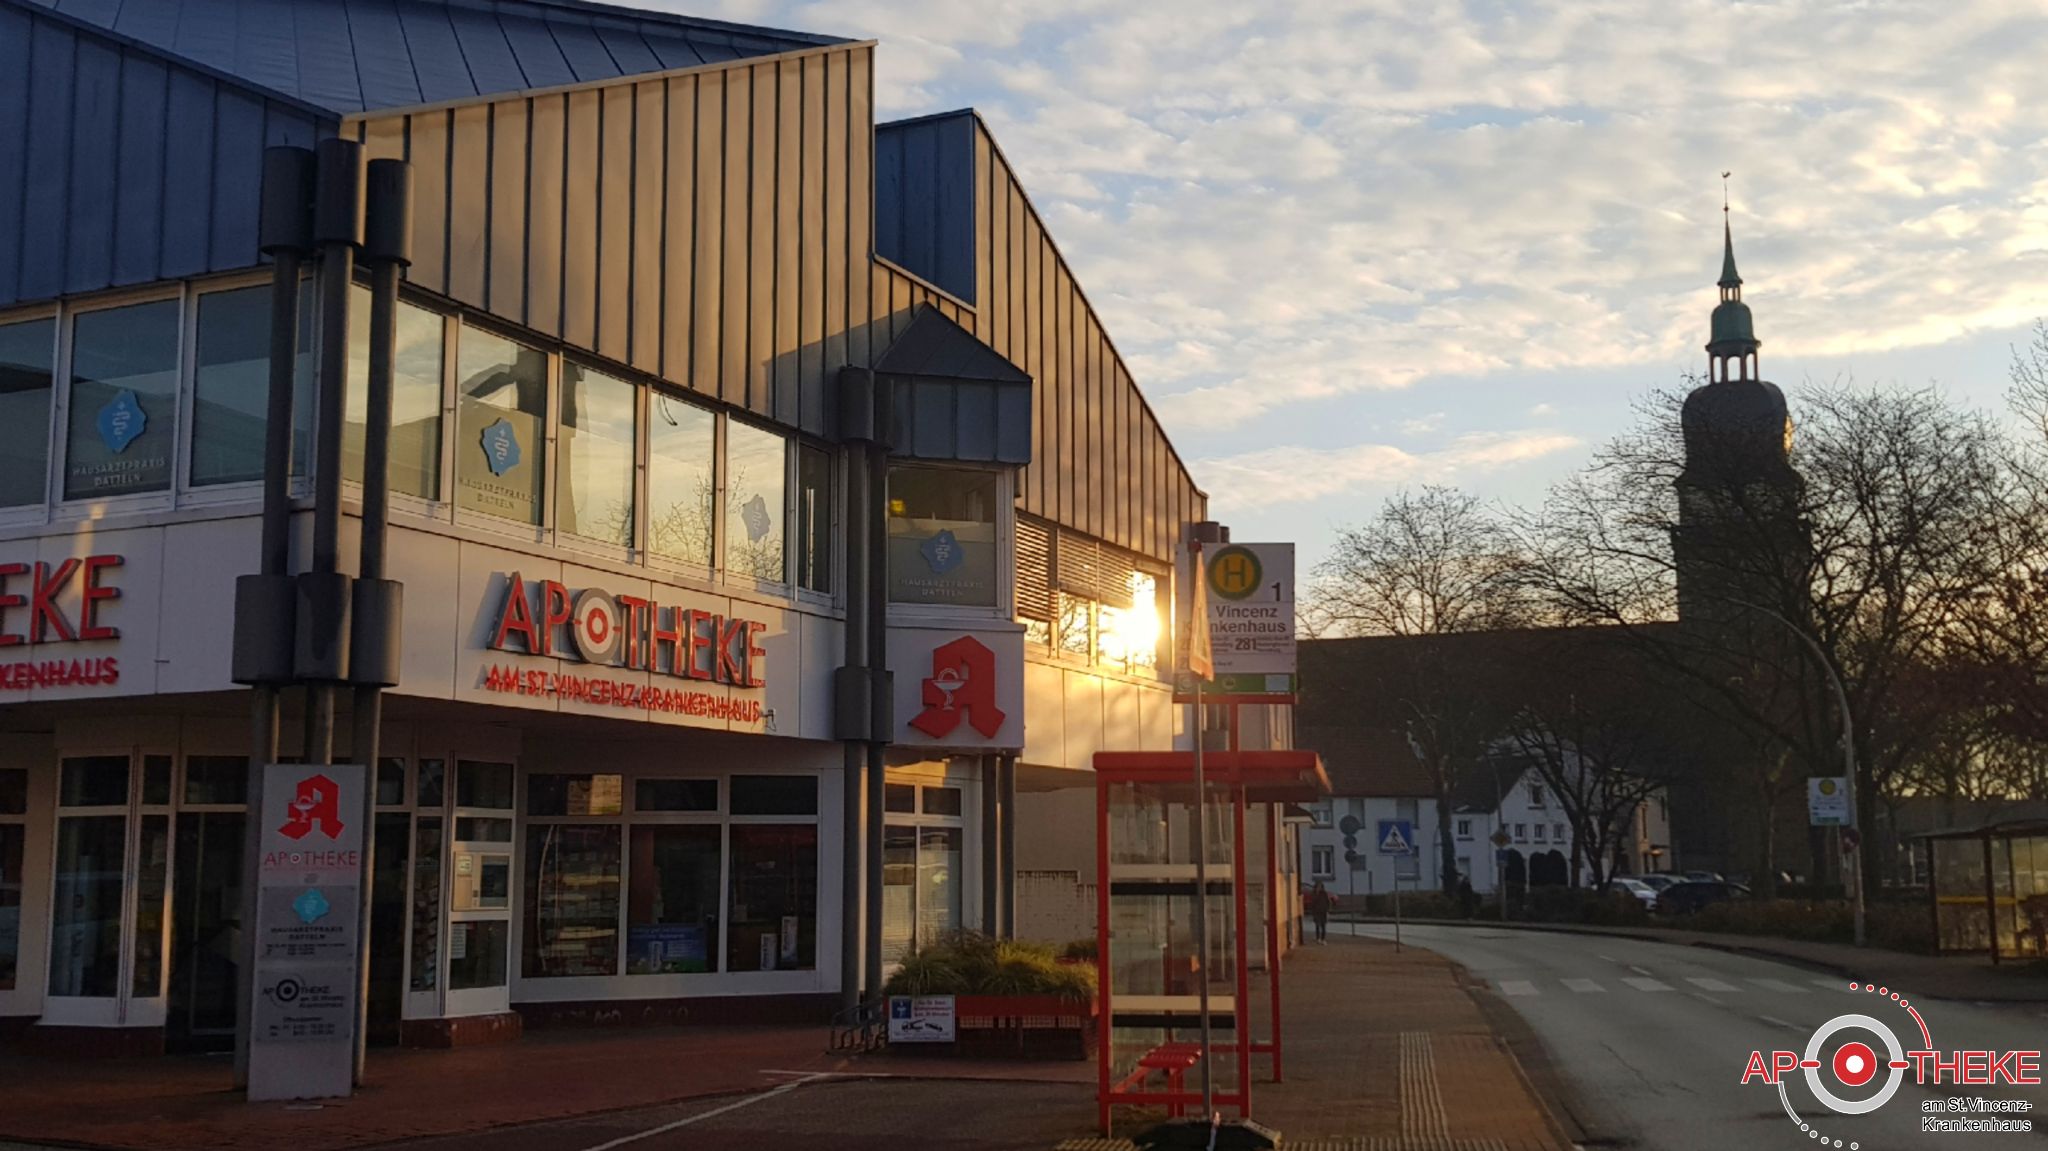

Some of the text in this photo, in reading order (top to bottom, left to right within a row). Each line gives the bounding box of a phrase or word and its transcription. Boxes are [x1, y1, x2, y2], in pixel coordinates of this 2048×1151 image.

[1271, 582, 1281, 601] 1
[1215, 605, 1278, 618] Vincenz
[1234, 637, 1257, 651] 281
[485, 663, 520, 693] AM
